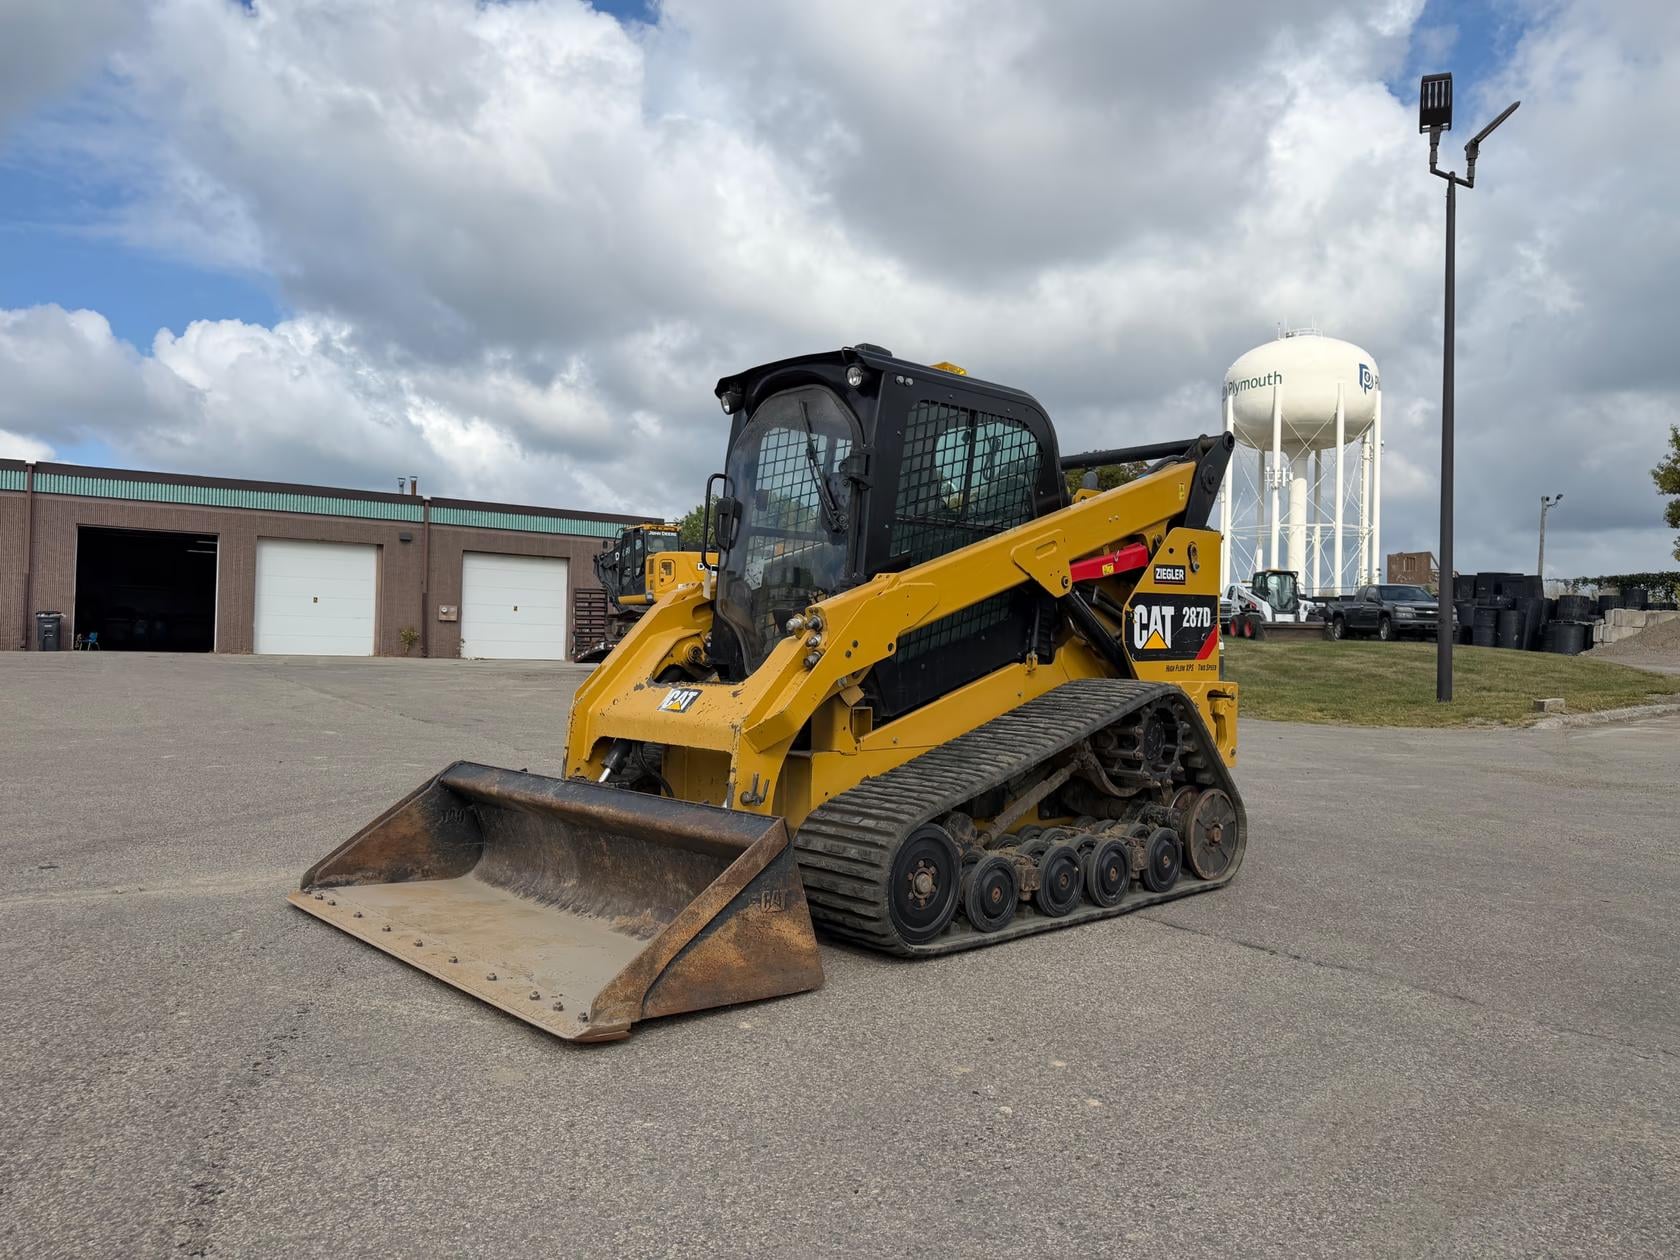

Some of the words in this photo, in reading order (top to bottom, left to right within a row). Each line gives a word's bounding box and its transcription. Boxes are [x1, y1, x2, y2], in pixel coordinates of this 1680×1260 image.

[1228, 371, 1282, 396] Plymouth
[1155, 567, 1185, 580] ZIEGLER
[1133, 604, 1175, 650] CAT
[1182, 606, 1211, 628] 287D
[660, 689, 699, 711] CAT
